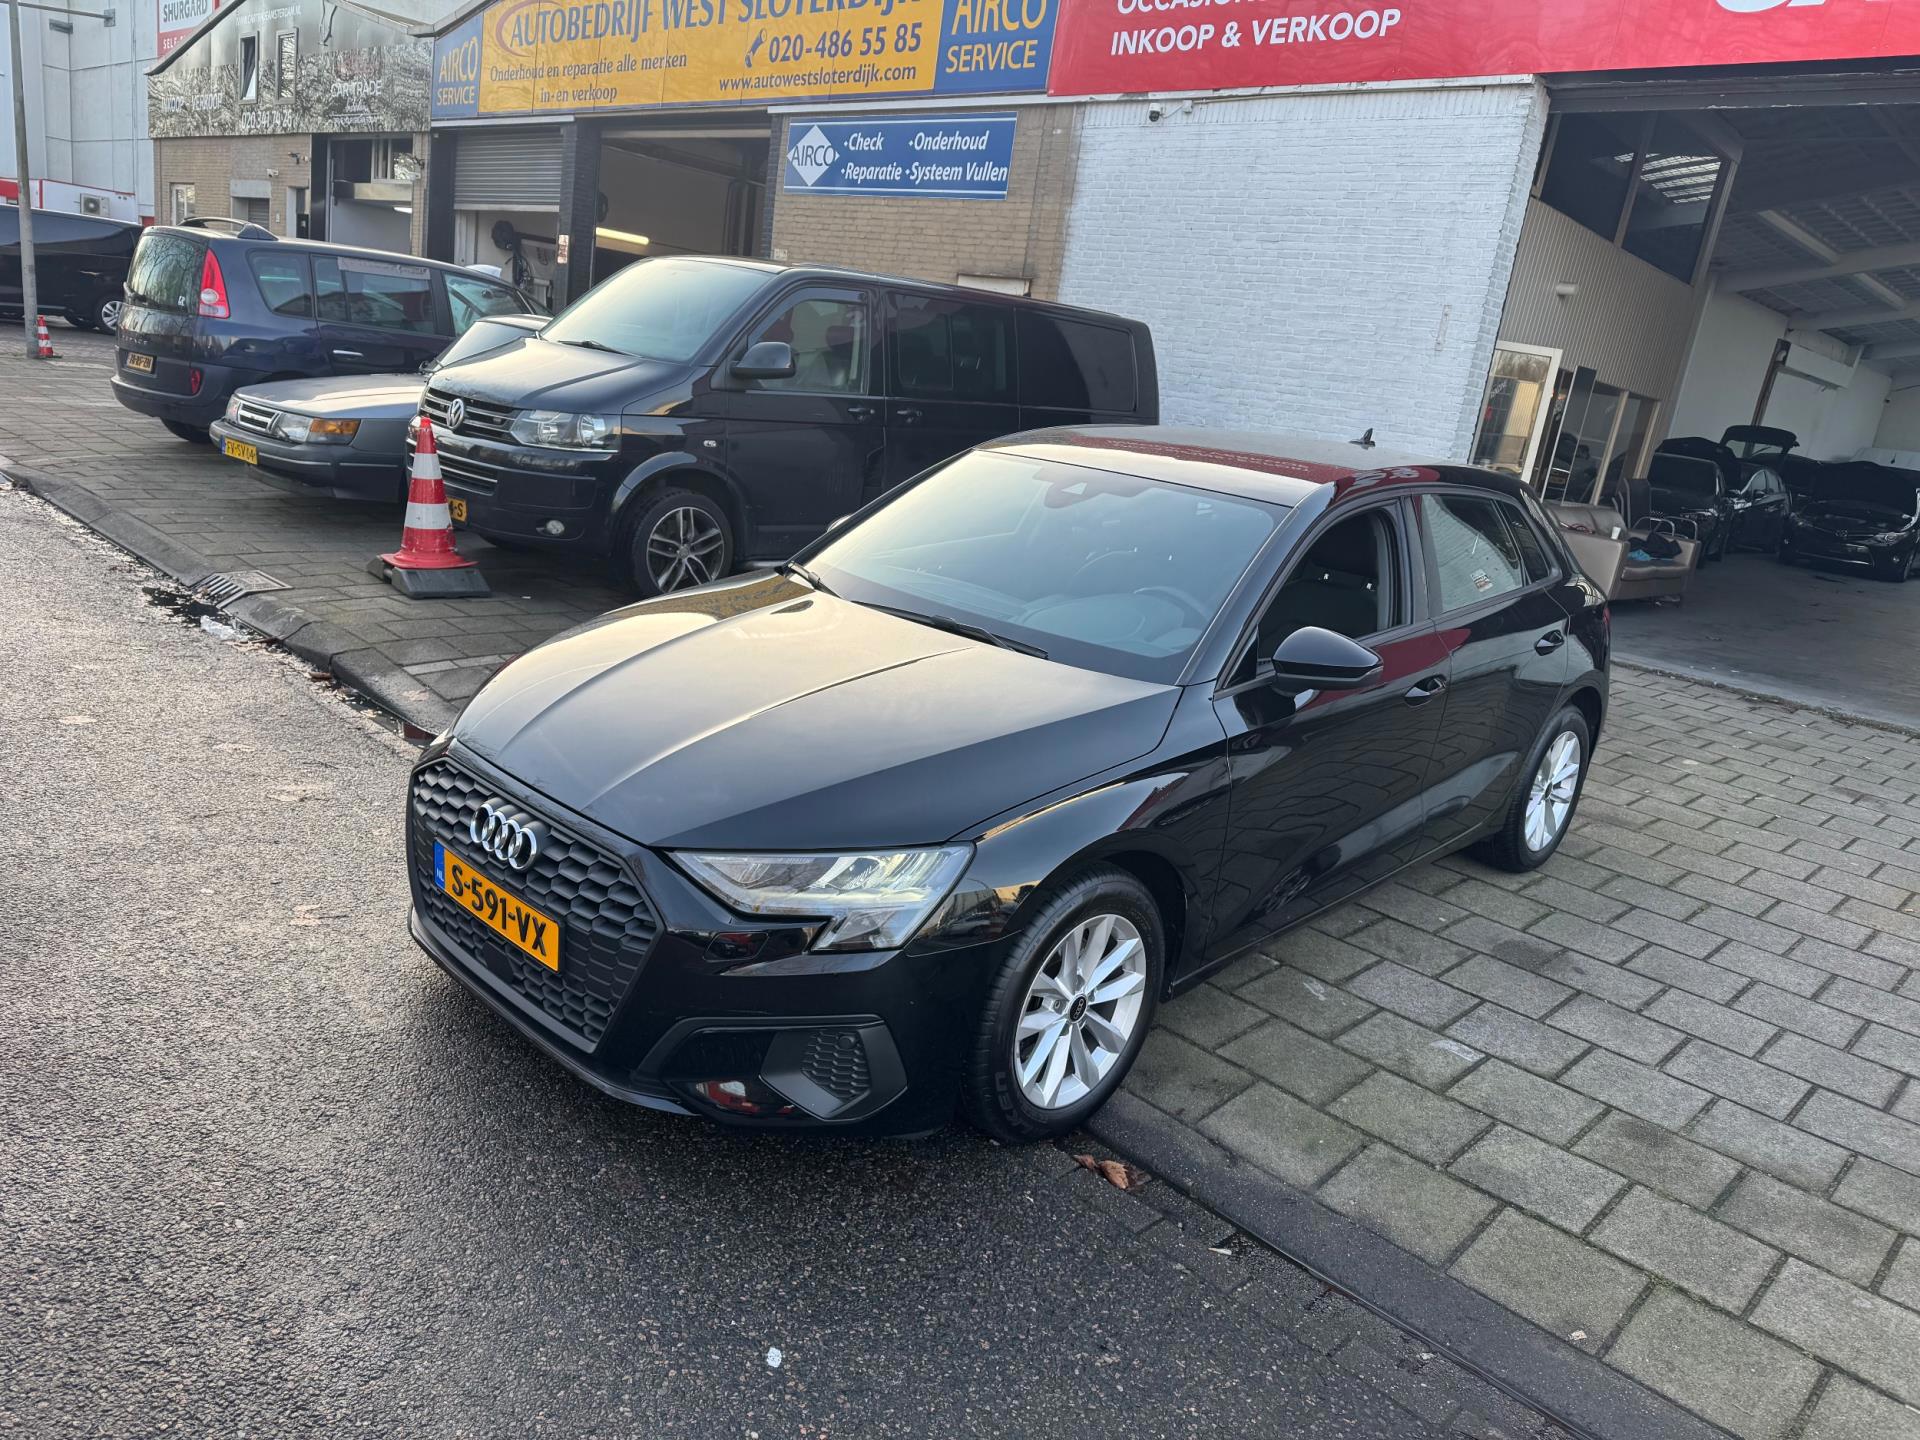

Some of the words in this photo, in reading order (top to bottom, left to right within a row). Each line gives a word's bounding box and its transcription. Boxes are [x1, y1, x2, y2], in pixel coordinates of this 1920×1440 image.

[163, 0, 208, 23] SHURGARD
[510, 0, 653, 48] AUTOBEDRIJF
[662, 0, 727, 30] WEST
[952, 0, 1046, 35] AIRCO
[769, 30, 852, 63] 020-486
[860, 26, 887, 56] 55
[894, 22, 923, 53] 85
[1111, 24, 1215, 56] INKOOP
[1221, 21, 1243, 48] &
[1251, 8, 1401, 46] VERKOOP
[439, 36, 478, 84] AIRCO
[490, 58, 544, 82] Onderhoud
[548, 62, 559, 78] en
[563, 56, 613, 80] reparatie
[617, 55, 636, 72] alle
[641, 53, 687, 71] merken
[946, 40, 1038, 73] SERVICE
[572, 85, 617, 103] verkoop
[719, 63, 916, 91] www.autowestsloterdijk.com
[437, 85, 474, 106] SERVICE
[791, 145, 834, 167] AIRCO
[849, 132, 885, 151] Check
[914, 130, 989, 151] Onderhoud
[845, 161, 902, 182] Reparatie
[909, 162, 963, 183] Systeem
[966, 161, 1008, 183] Vullen
[451, 864, 547, 957] S-591-VX
